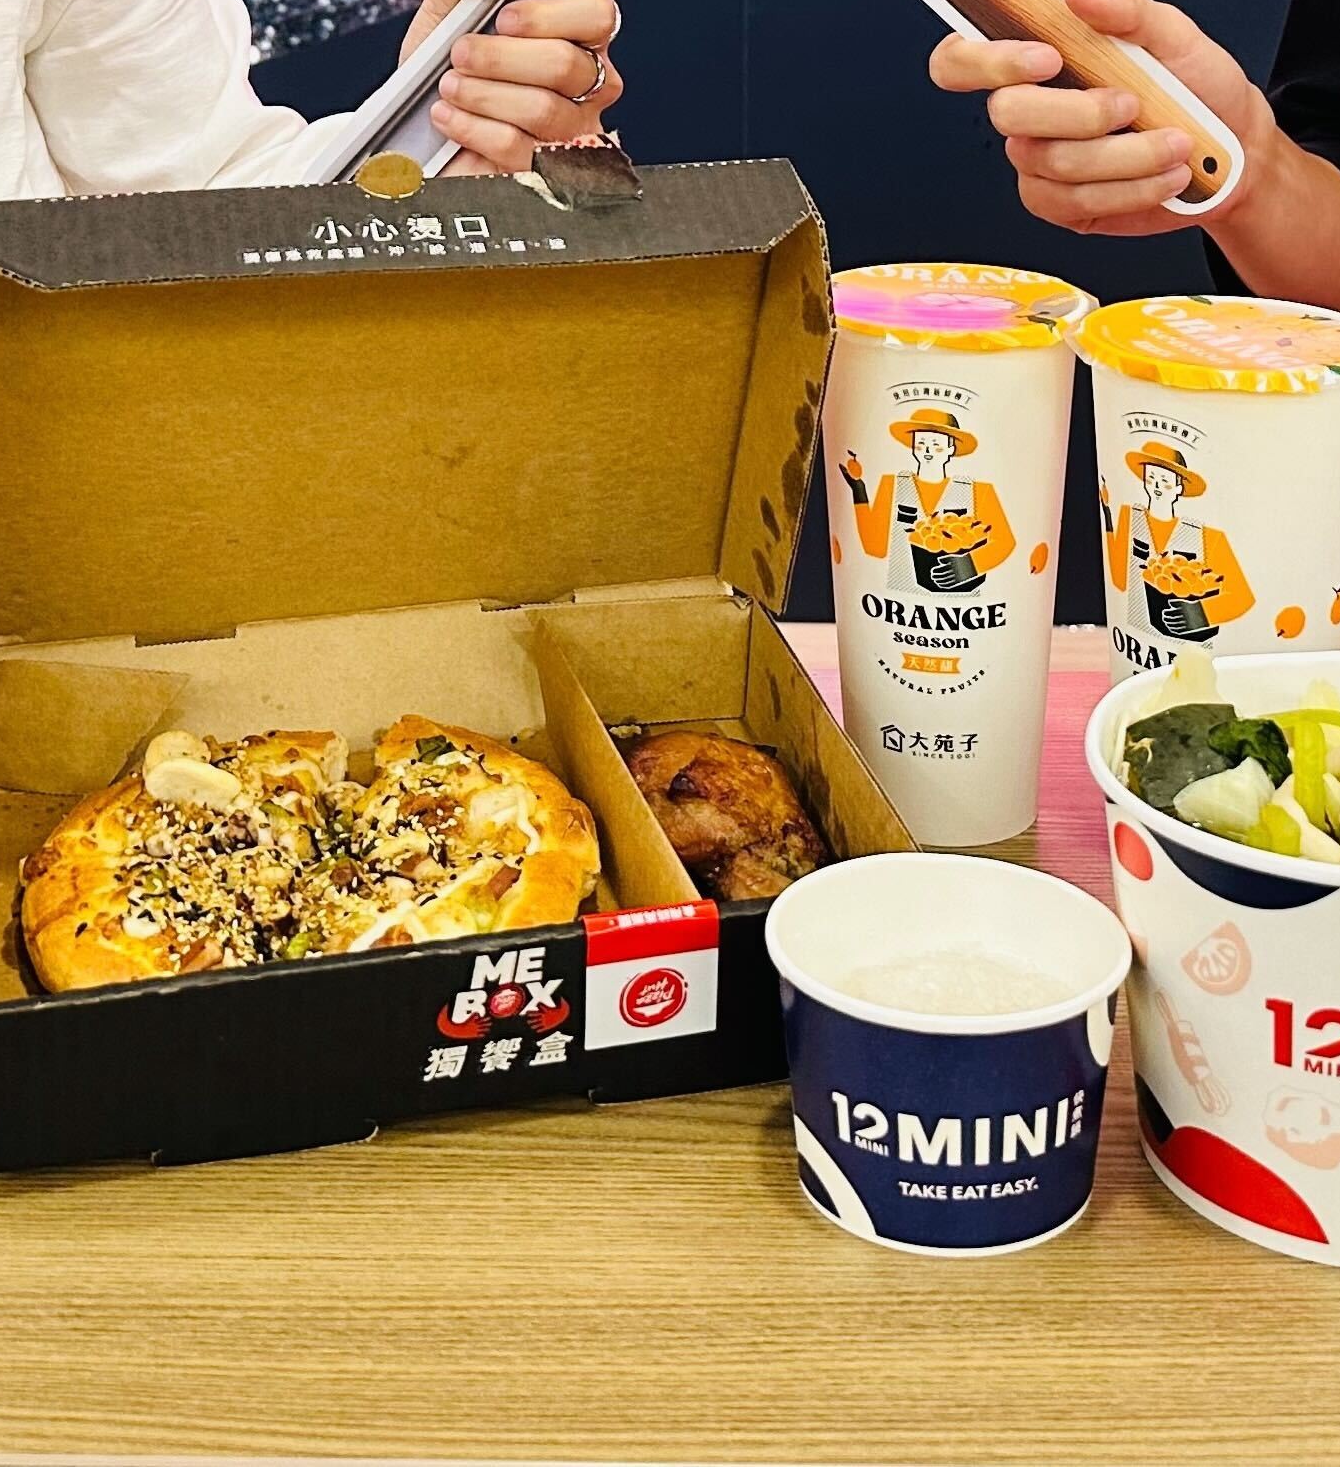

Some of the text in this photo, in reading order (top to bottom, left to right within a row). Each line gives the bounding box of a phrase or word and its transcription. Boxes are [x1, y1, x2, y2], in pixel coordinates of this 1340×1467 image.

[314, 216, 491, 245] 小心燙口
[861, 593, 1007, 632] ORANGE
[892, 631, 970, 649] season
[1112, 626, 1178, 670] ORA
[877, 659, 986, 695] NATURAL FRUITS
[908, 732, 980, 753] 大苑子
[470, 946, 546, 990] ME
[634, 983, 676, 1007] Pizza
[640, 976, 669, 996] Hut
[423, 1030, 575, 1082] 獨饗盒
[831, 1090, 1069, 1167] 12 MINI
[854, 1135, 890, 1158] MINI
[898, 1176, 1039, 1201] TAKE EAT EASY.
